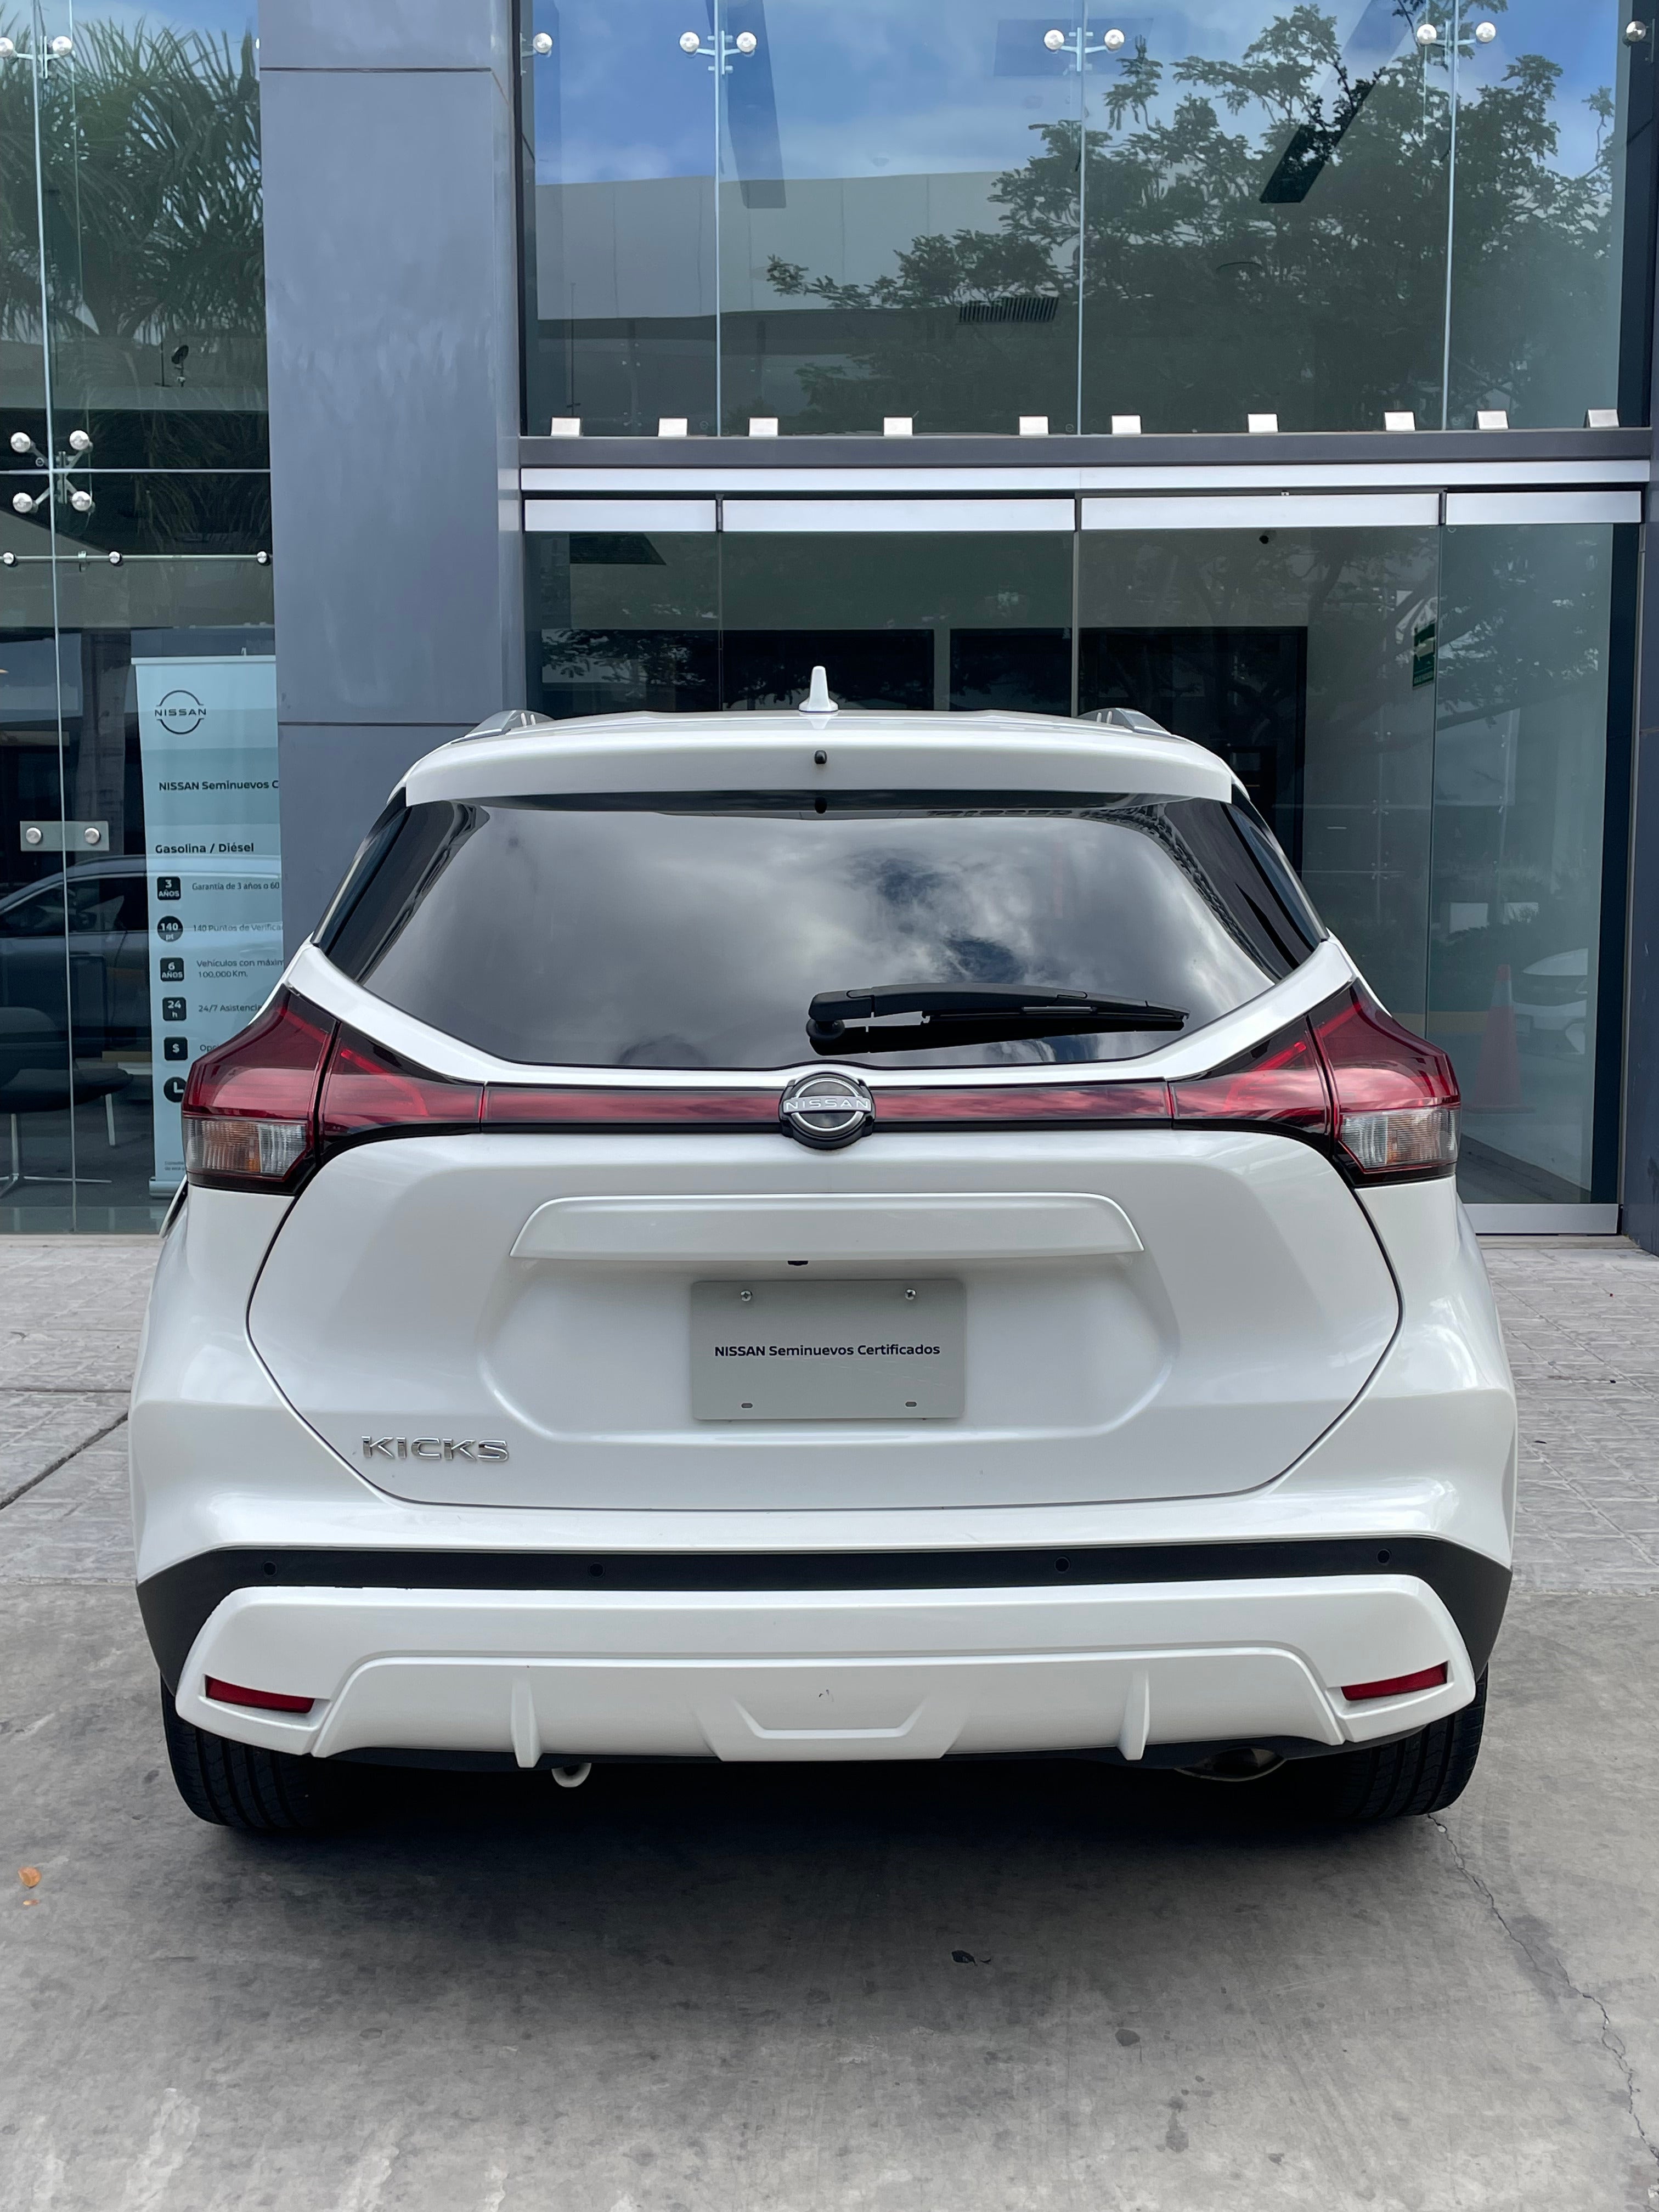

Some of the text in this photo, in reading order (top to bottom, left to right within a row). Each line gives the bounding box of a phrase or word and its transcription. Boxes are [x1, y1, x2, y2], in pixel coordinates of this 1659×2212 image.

[155, 708, 206, 716] NISSAN
[159, 782, 199, 791] NISSAN
[202, 780, 269, 790] Seminuevos
[155, 843, 254, 854] Gasolina / Diésel
[165, 879, 172, 888] 3
[160, 923, 178, 931] 140
[196, 959, 238, 967] Vehículos
[167, 1000, 181, 1009] 24
[786, 1098, 868, 1110] NISSAN
[715, 1344, 940, 1357] NISSAN Seminuevos Certificados
[361, 1435, 510, 1462] KICKS
